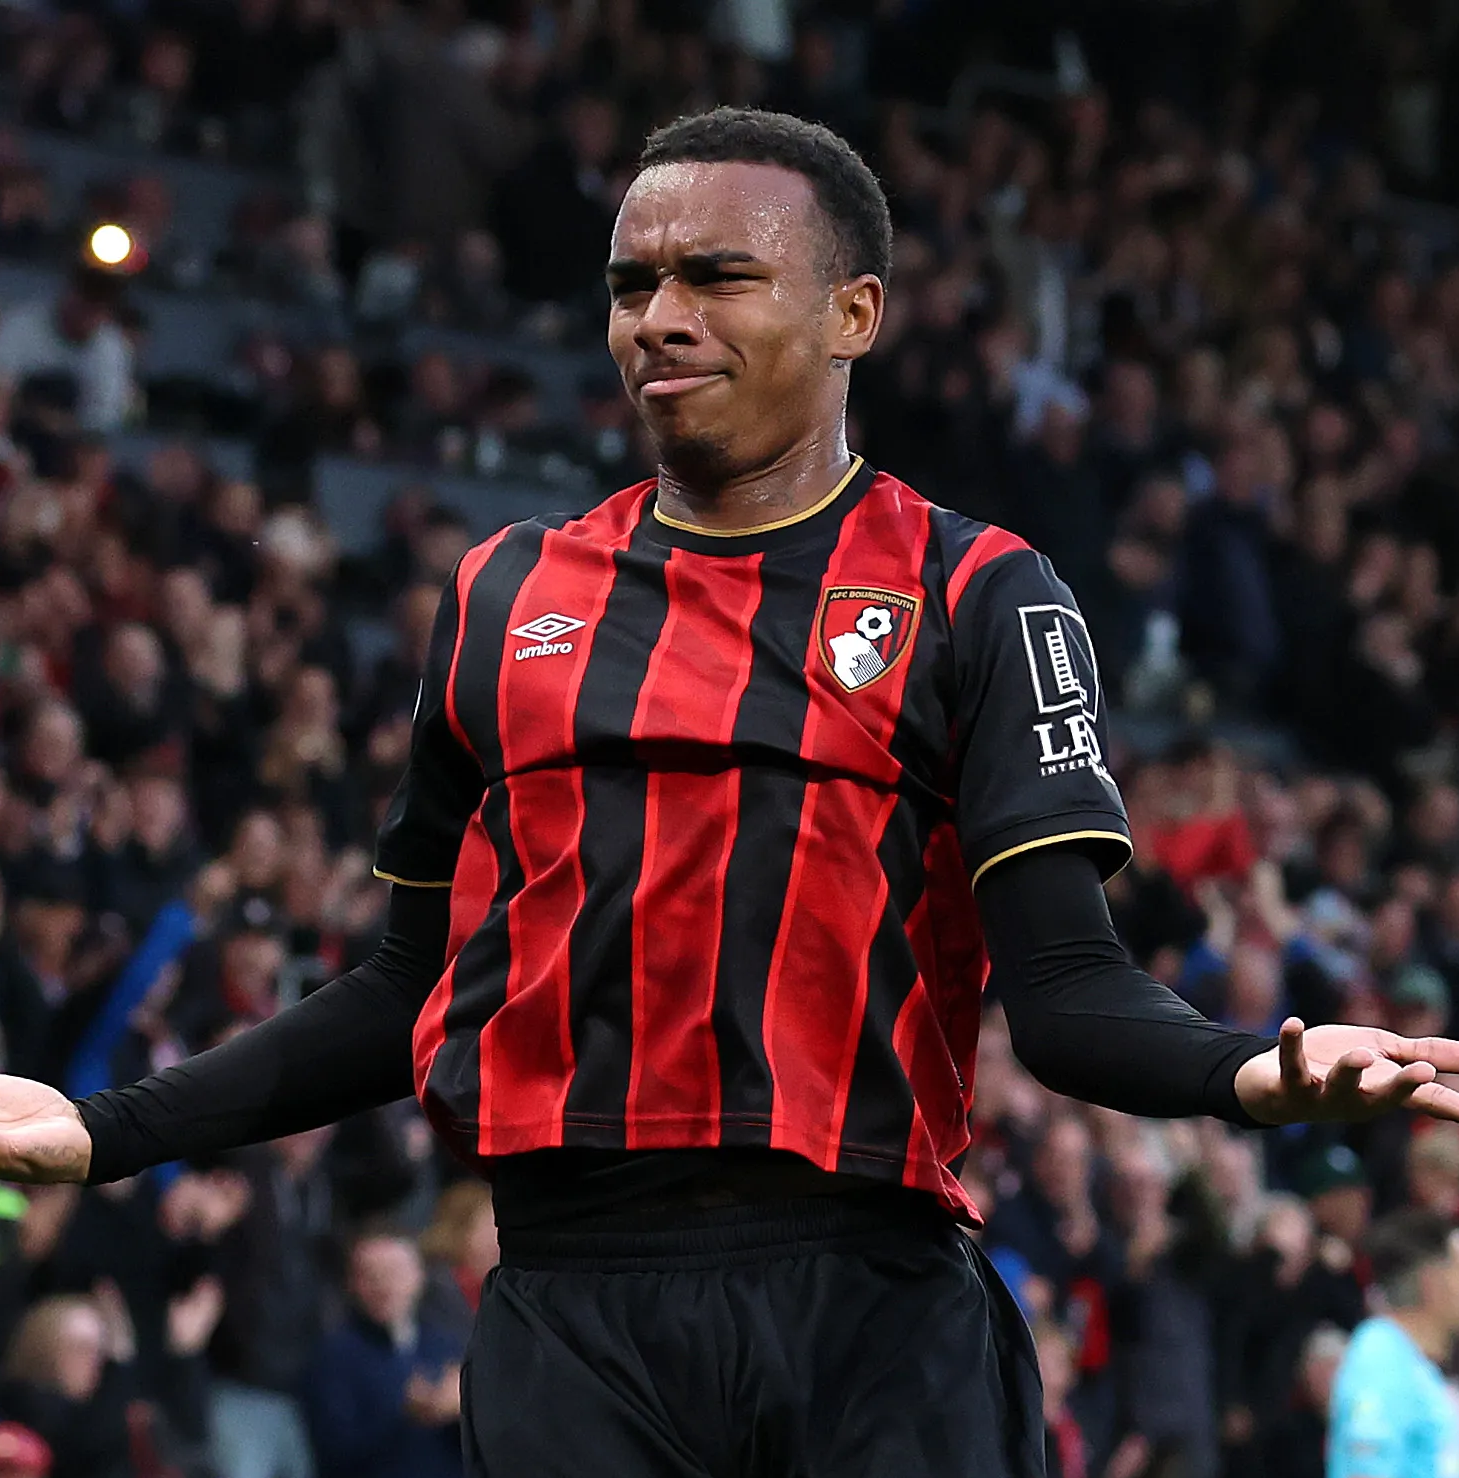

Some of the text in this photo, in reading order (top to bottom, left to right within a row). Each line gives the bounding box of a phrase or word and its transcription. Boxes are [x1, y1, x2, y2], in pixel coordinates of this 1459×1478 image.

[830, 591, 914, 611] AFC BOURNEMOUTH
[515, 641, 573, 661] umbro
